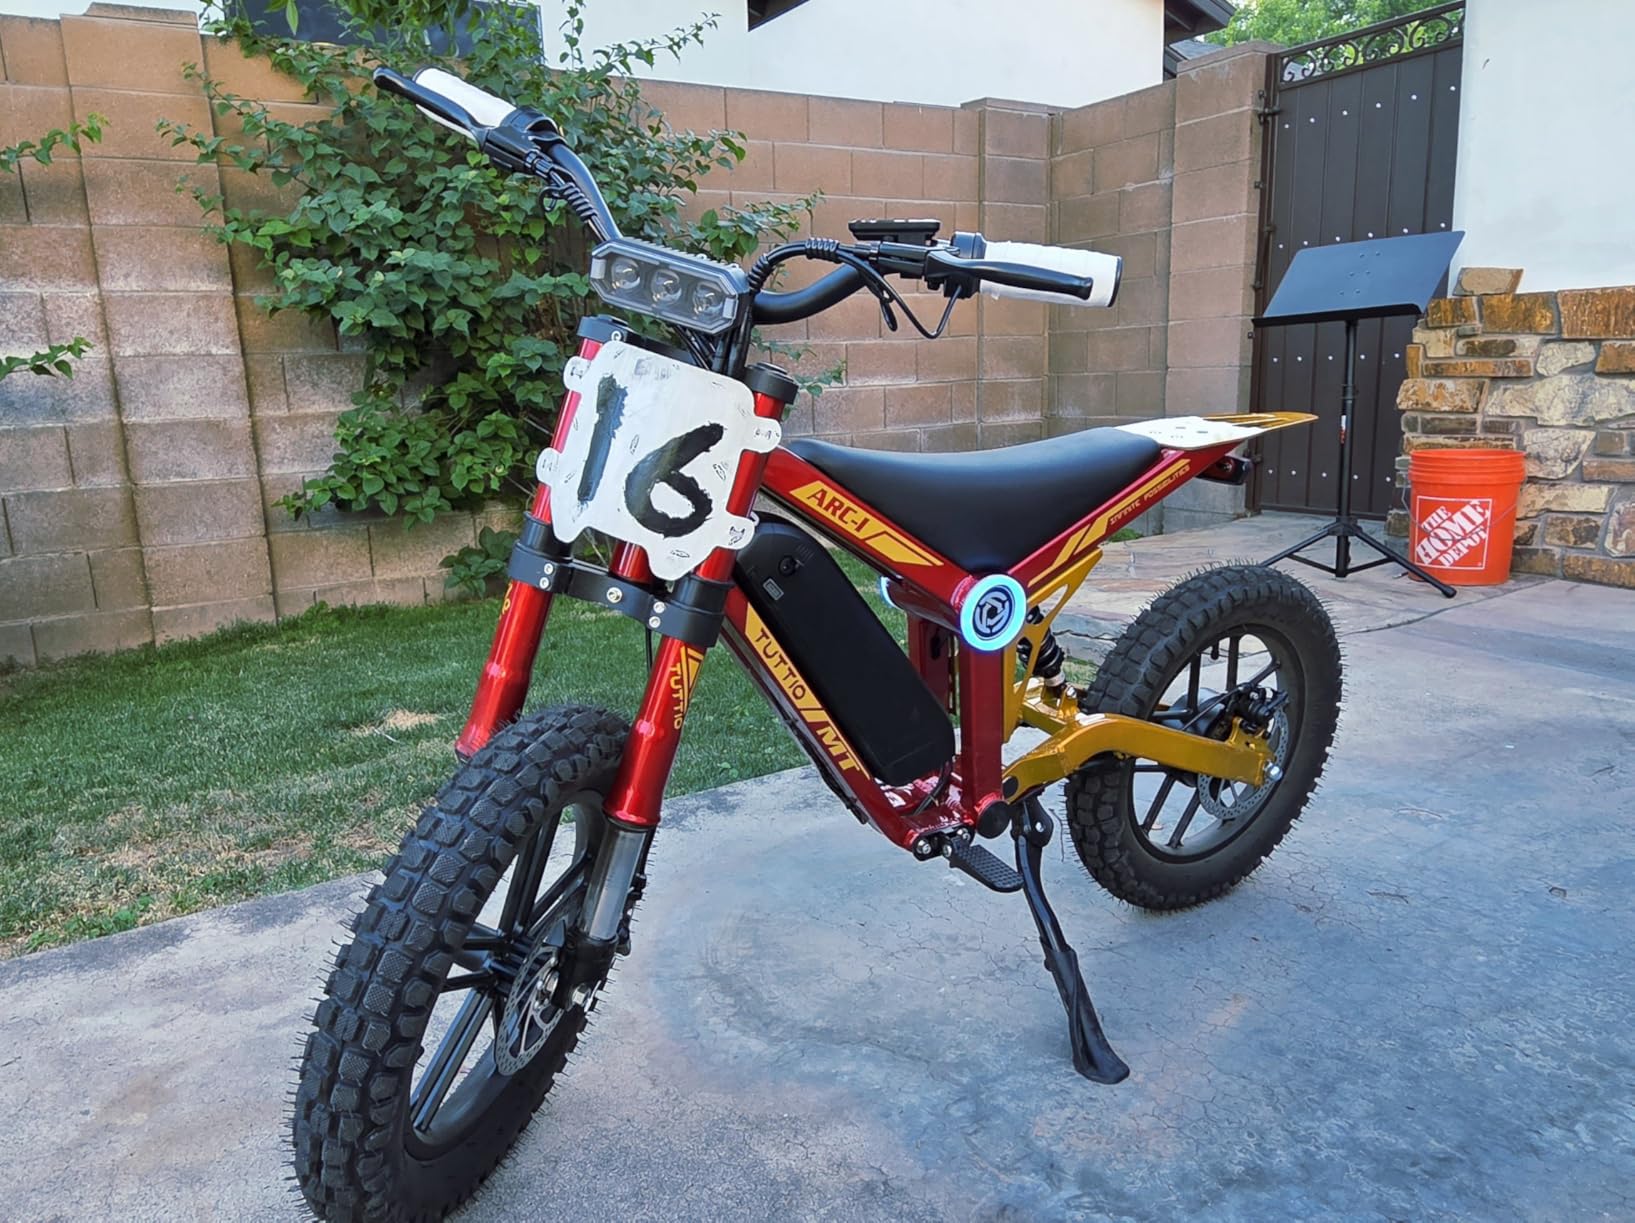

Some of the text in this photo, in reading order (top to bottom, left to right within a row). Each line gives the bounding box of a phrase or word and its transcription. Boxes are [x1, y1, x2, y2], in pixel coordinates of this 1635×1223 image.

[576, 373, 724, 538] 16
[1416, 500, 1489, 565] HOME
[1421, 505, 1452, 533] THE
[1438, 525, 1487, 567] DEPOT
[670, 662, 684, 730] TUTTIO
[756, 627, 860, 771] TUTTIO MT
